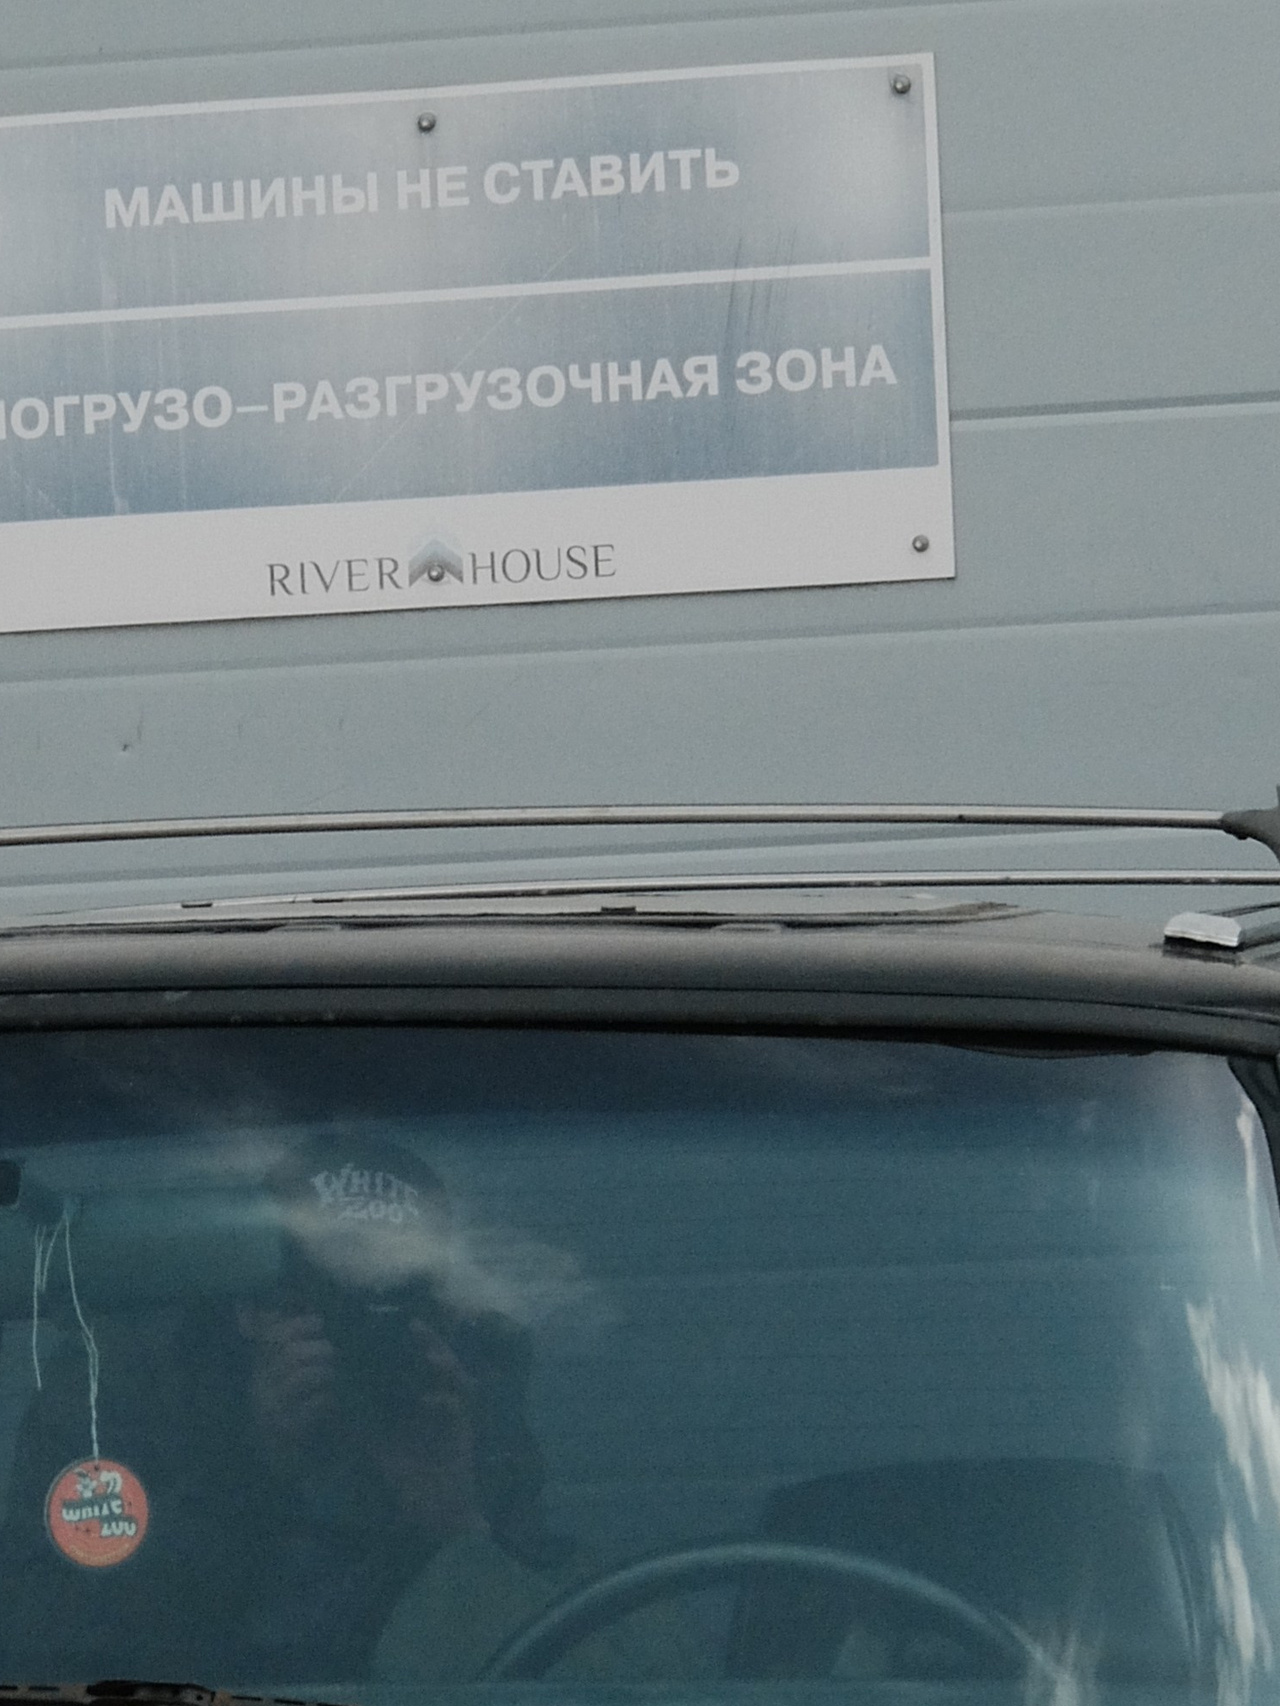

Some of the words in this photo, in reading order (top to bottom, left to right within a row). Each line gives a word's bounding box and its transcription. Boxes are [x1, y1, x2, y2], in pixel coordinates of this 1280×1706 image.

[104, 171, 379, 229] МАШИНЫ
[396, 165, 470, 210] НЕ
[483, 147, 740, 205] СТАВИТЬ
[735, 344, 898, 395] ЗОНА
[266, 556, 403, 597] RIVER
[467, 543, 617, 586] HOUSE
